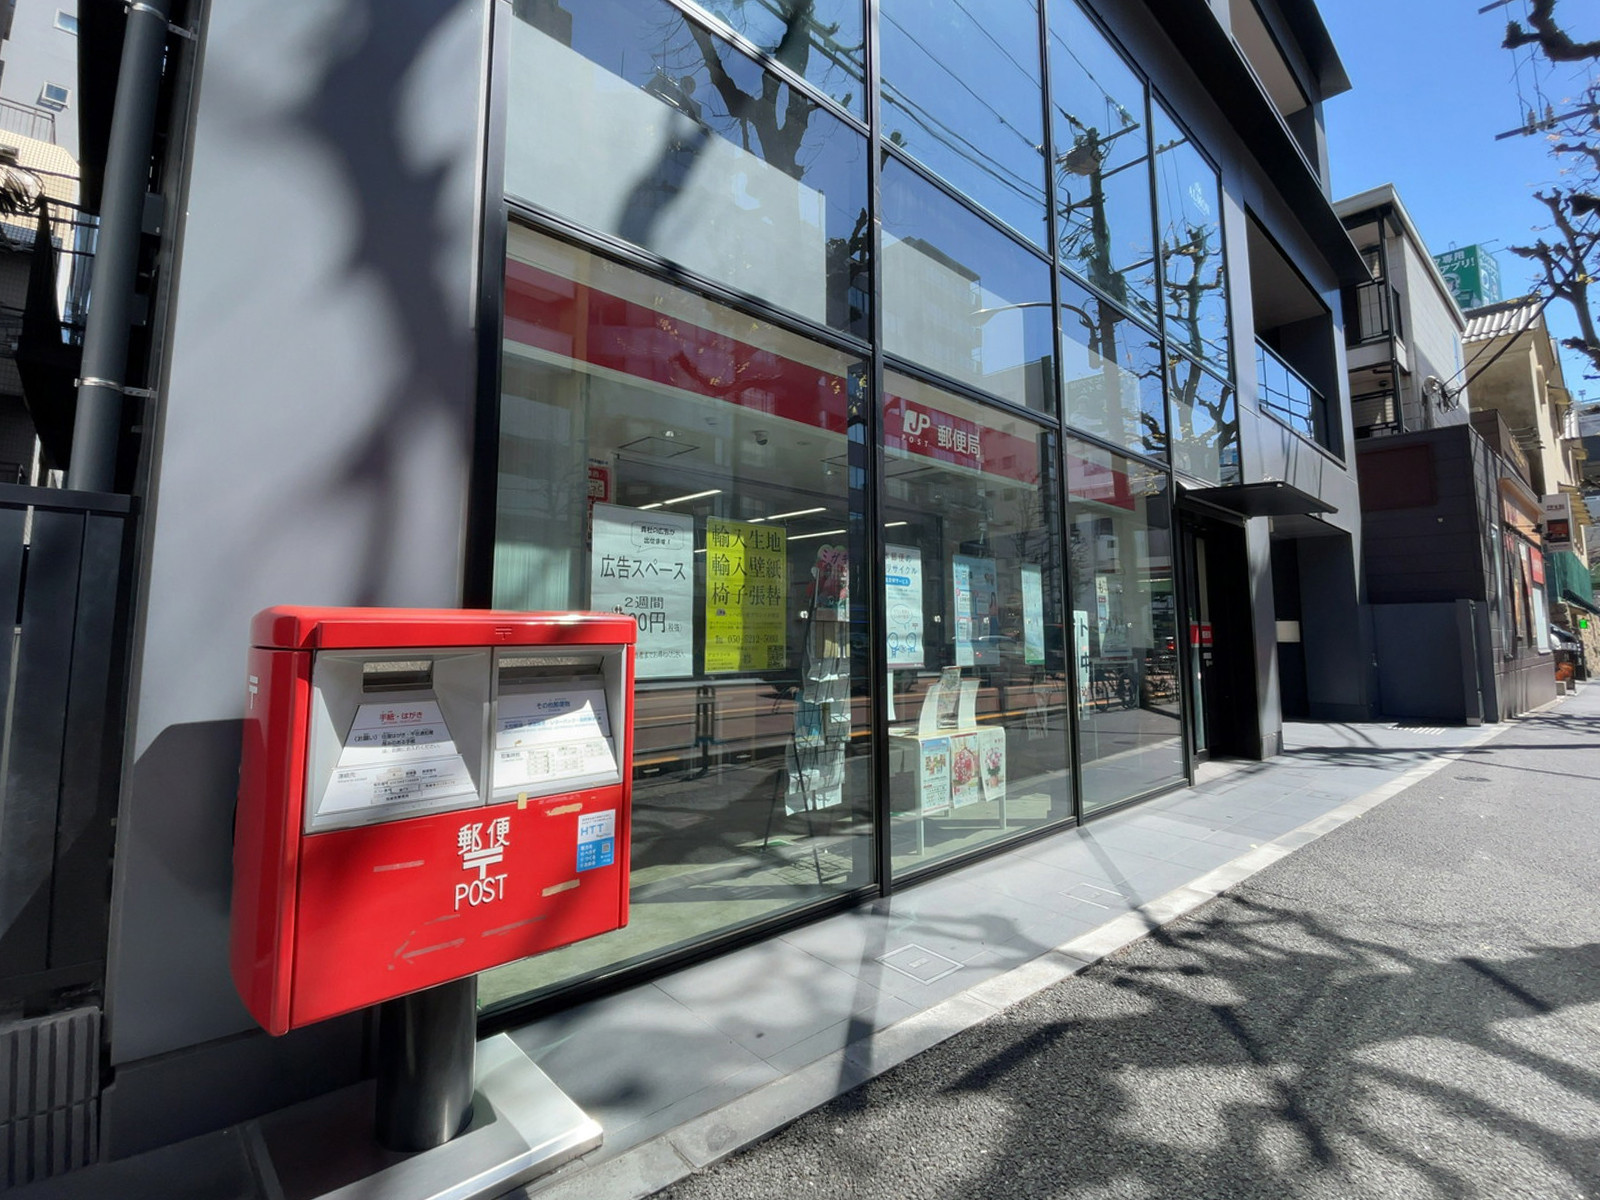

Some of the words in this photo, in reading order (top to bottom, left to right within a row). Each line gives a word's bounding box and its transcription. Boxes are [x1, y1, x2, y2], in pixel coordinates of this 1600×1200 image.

[901, 434, 929, 448] POST
[937, 424, 981, 458] 郵便局
[711, 524, 782, 553] 輸入生地
[600, 554, 686, 581] 広告スペース
[711, 553, 782, 579] 輸入壁紙
[711, 581, 781, 606] 椅子張替
[457, 817, 511, 855] 郵便
[581, 823, 605, 836] HTT
[455, 874, 508, 911] POST
